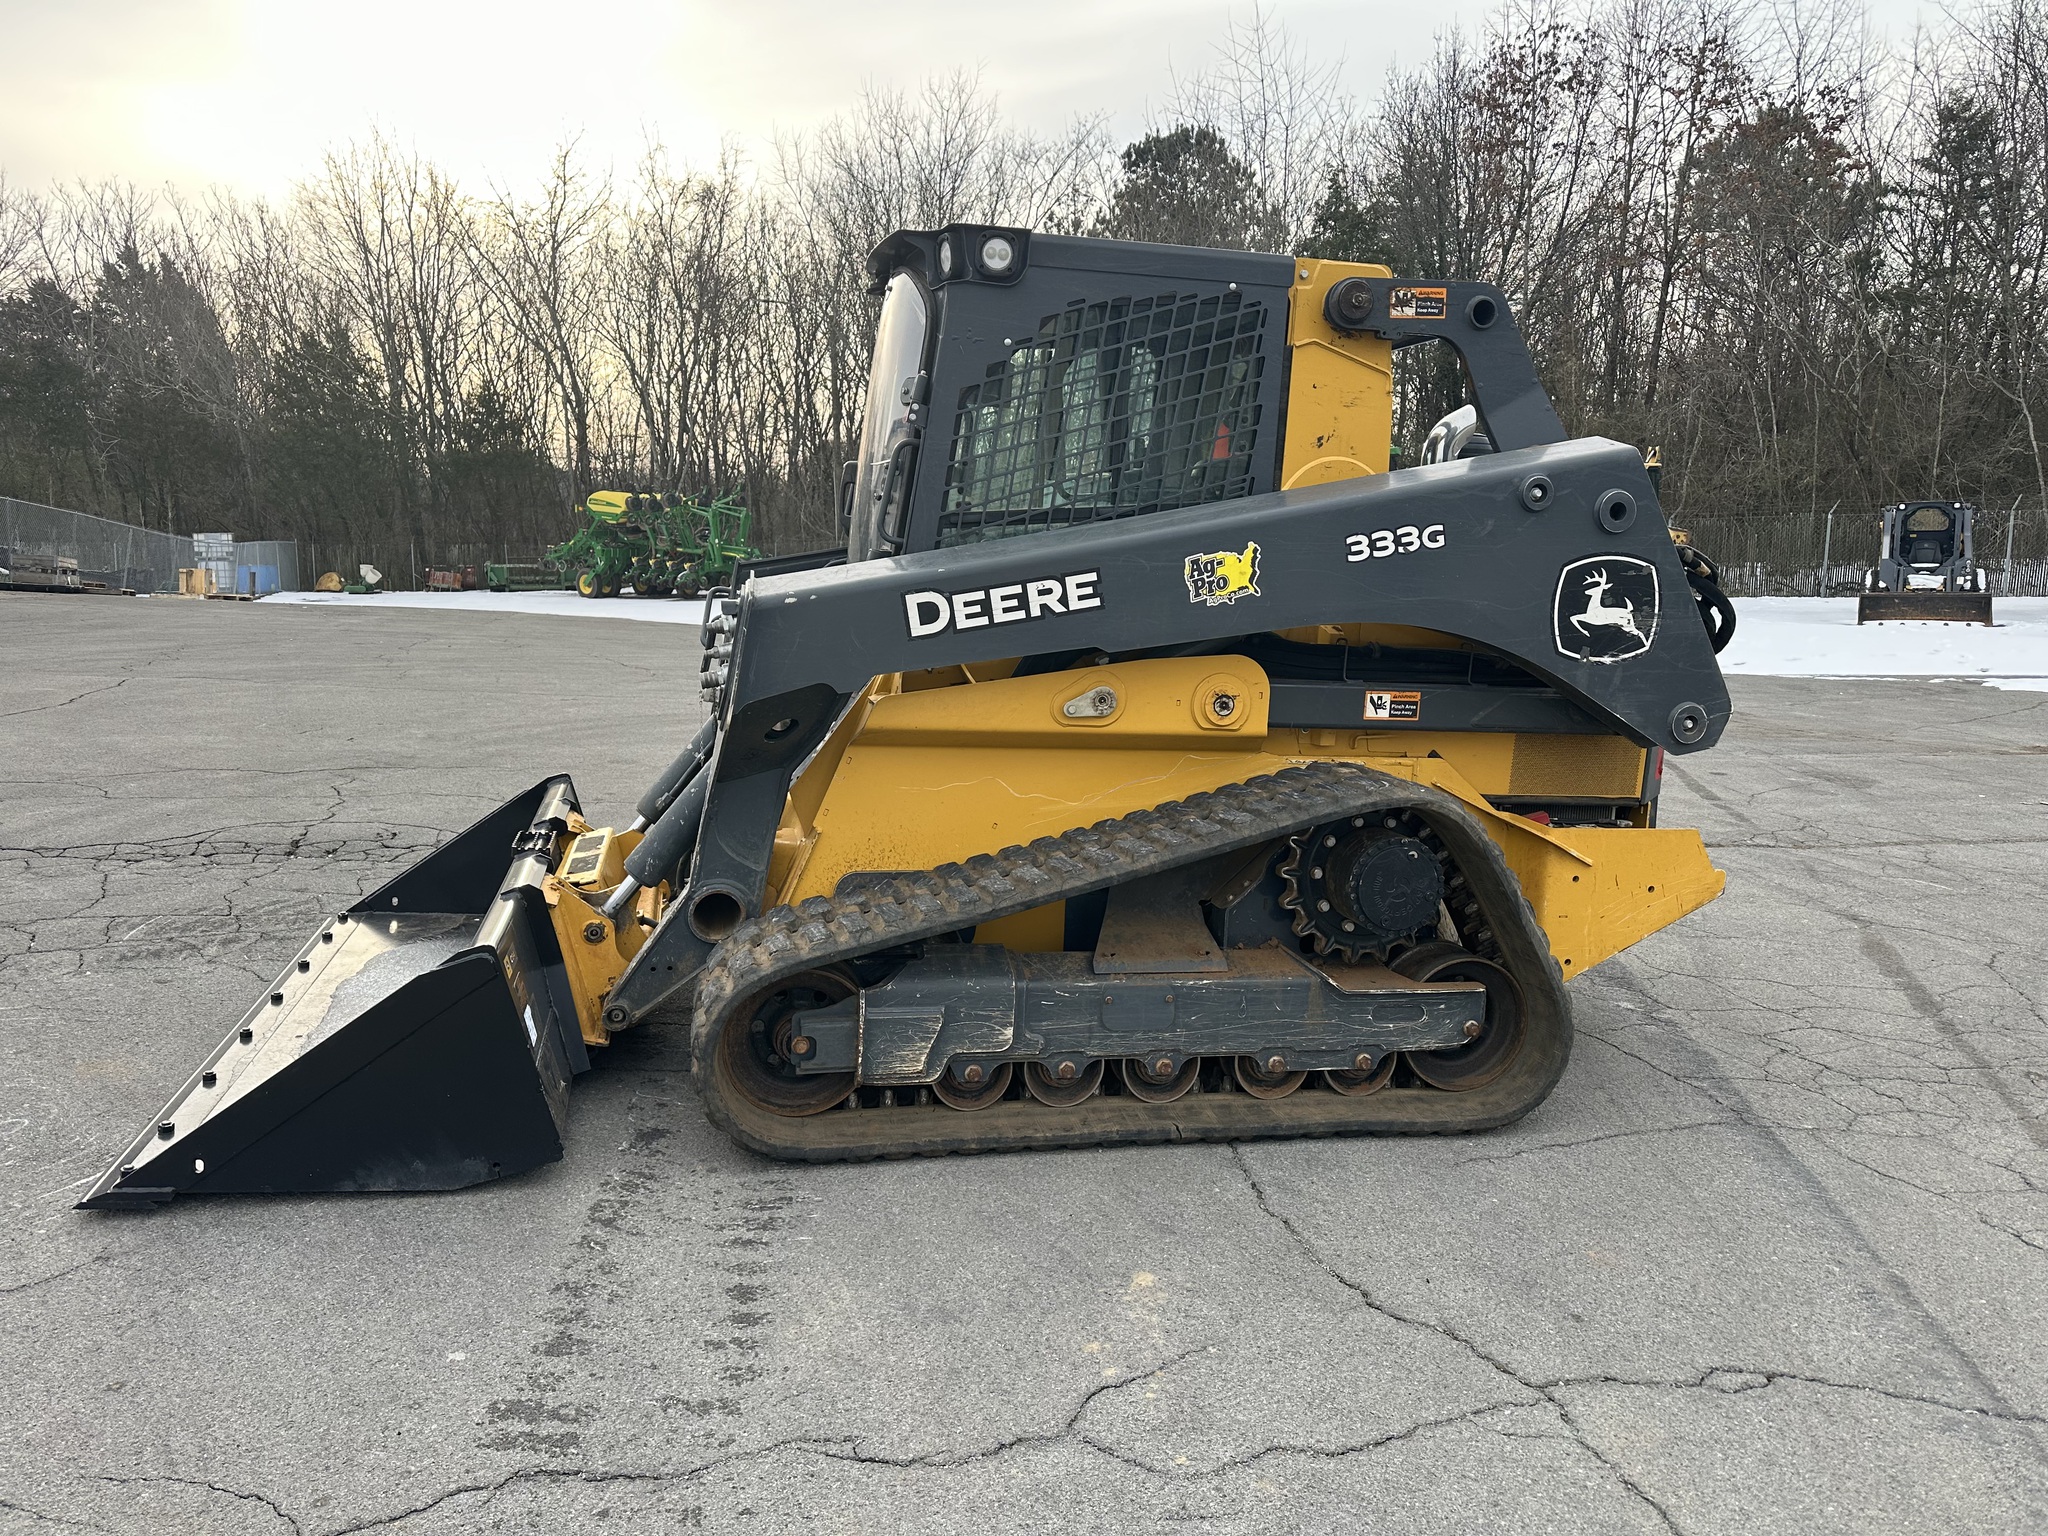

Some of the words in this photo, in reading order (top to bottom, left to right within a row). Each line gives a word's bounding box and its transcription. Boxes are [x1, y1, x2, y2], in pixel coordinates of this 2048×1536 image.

[1345, 524, 1446, 562] 333G
[1189, 558, 1224, 579] Ag-
[1191, 576, 1228, 598] Pro
[905, 571, 1101, 637] DEERE
